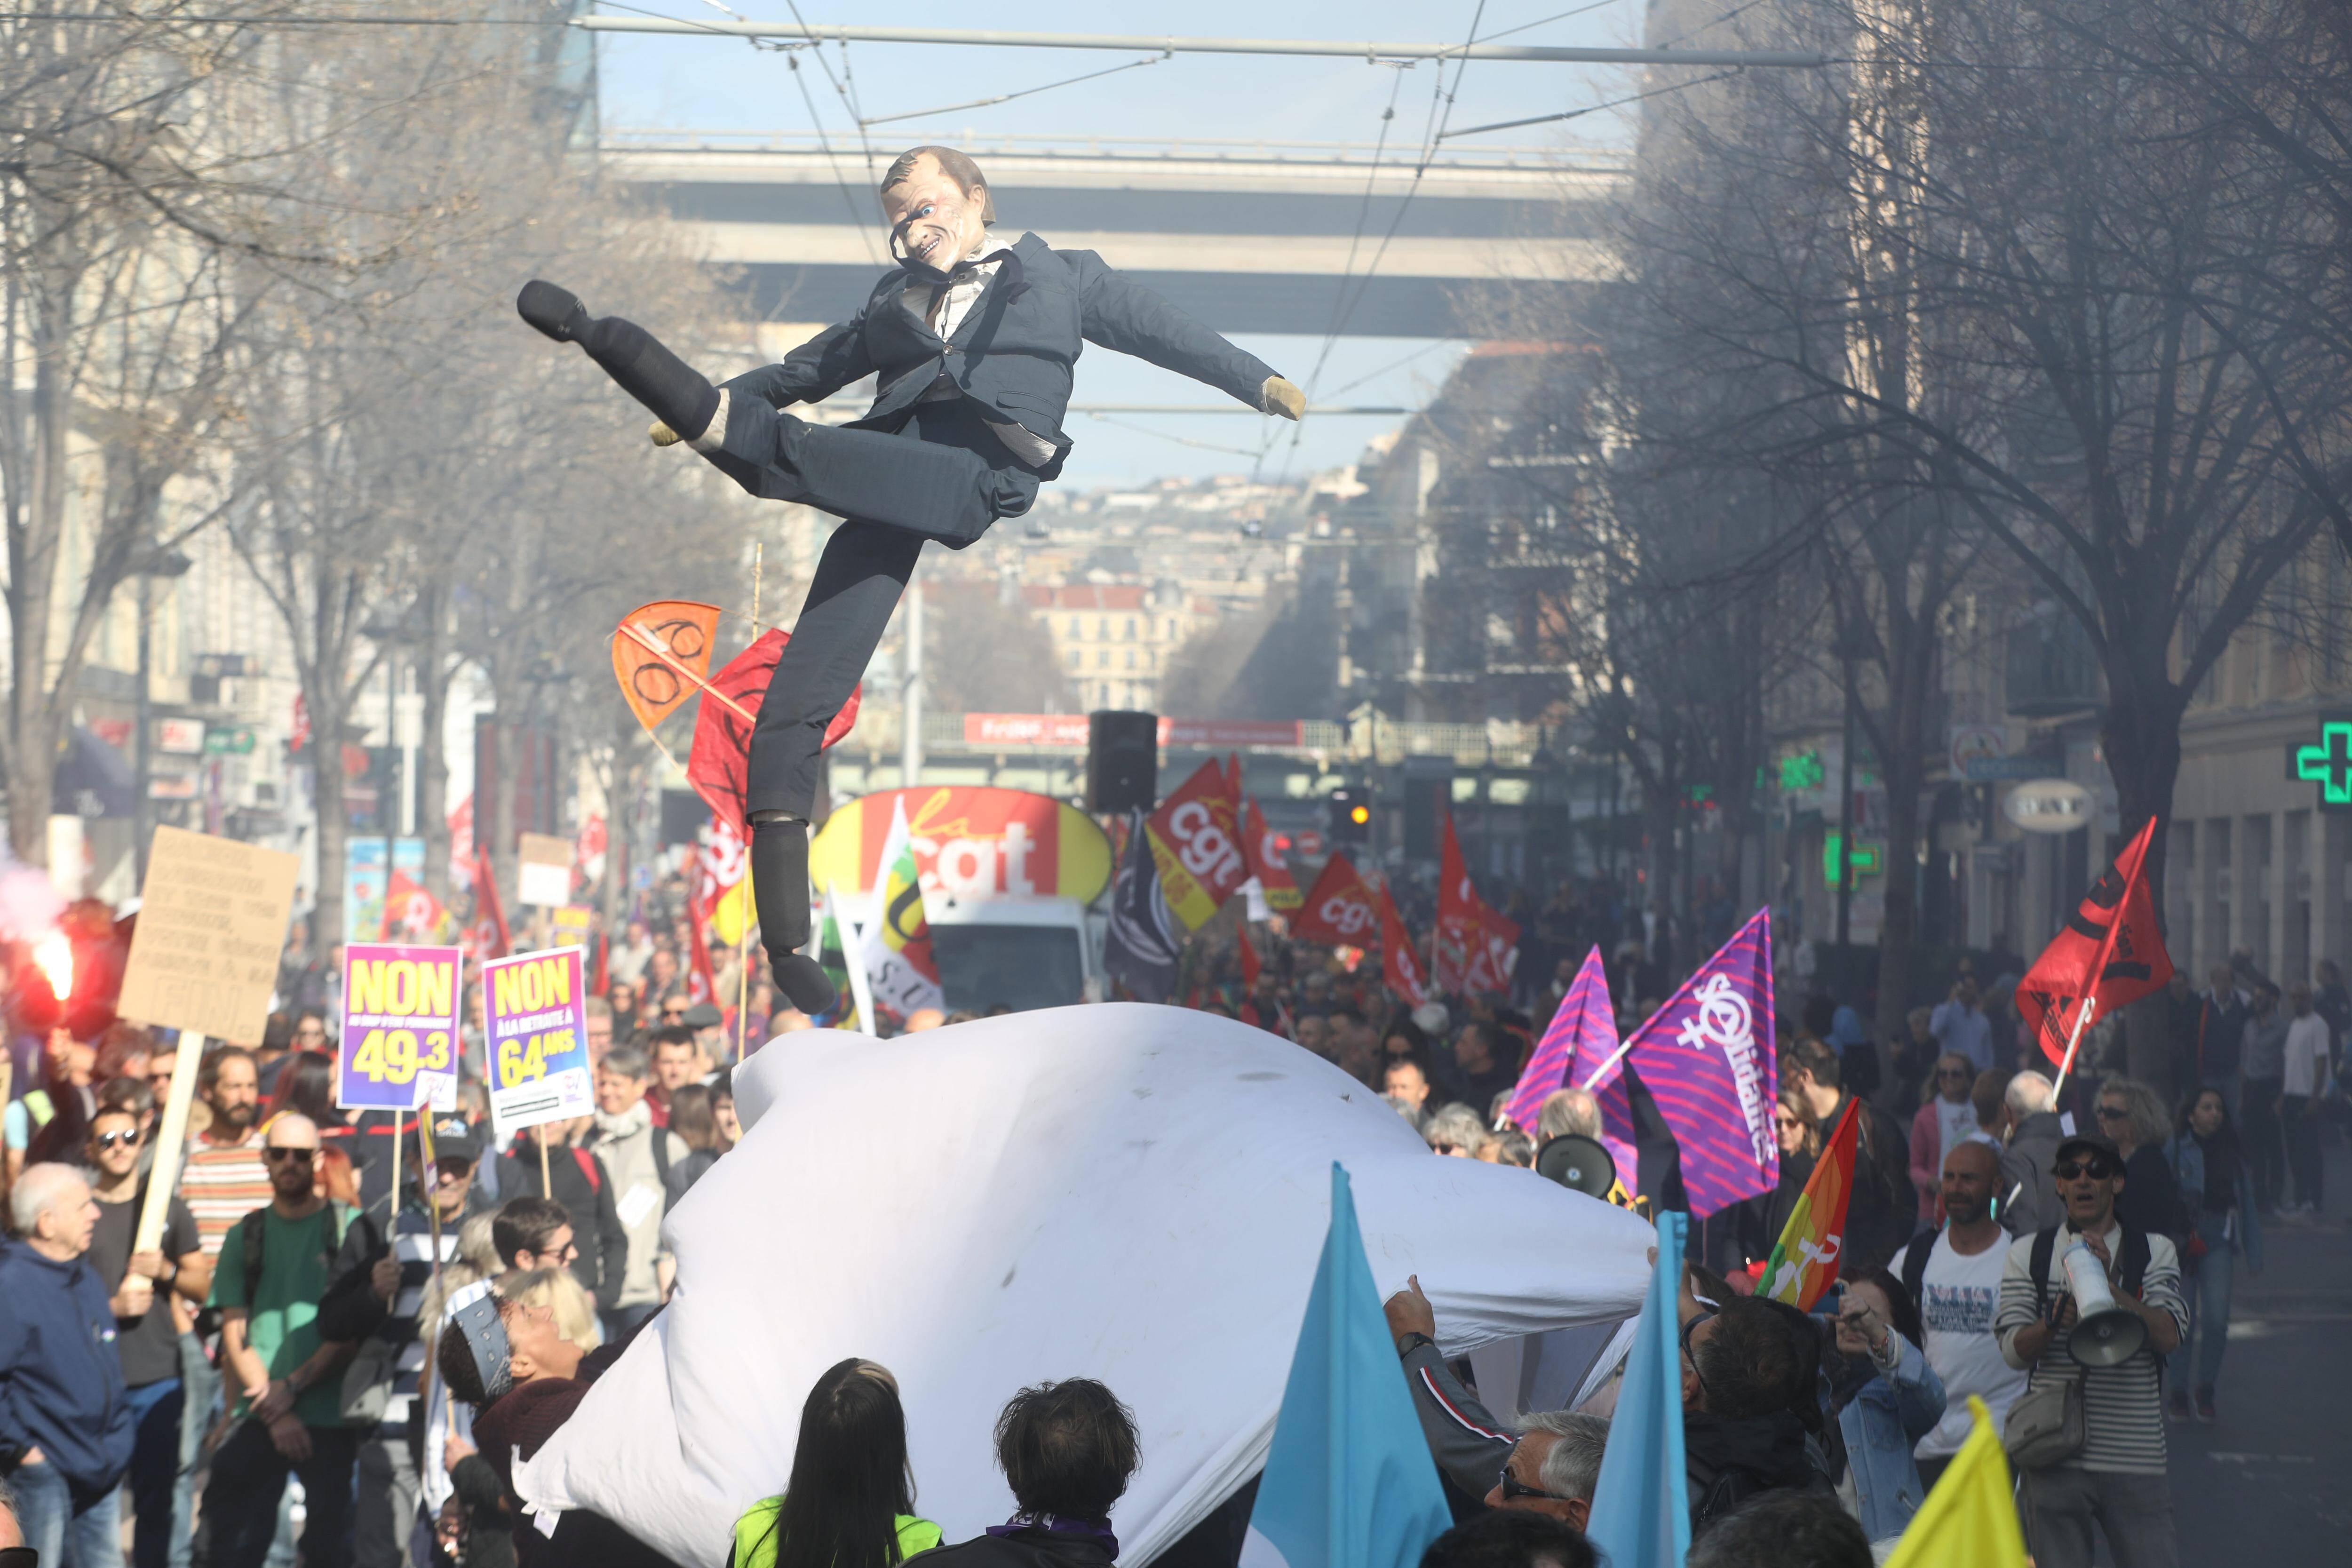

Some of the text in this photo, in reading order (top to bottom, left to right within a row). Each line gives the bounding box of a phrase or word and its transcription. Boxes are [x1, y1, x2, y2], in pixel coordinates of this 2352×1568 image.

[151, 976, 254, 1039] FIN.
[348, 958, 453, 1016] NON
[494, 956, 571, 1018] NON
[352, 1029, 450, 1084] 49.3
[497, 1034, 547, 1088] 64
[542, 1027, 576, 1057] ANS
